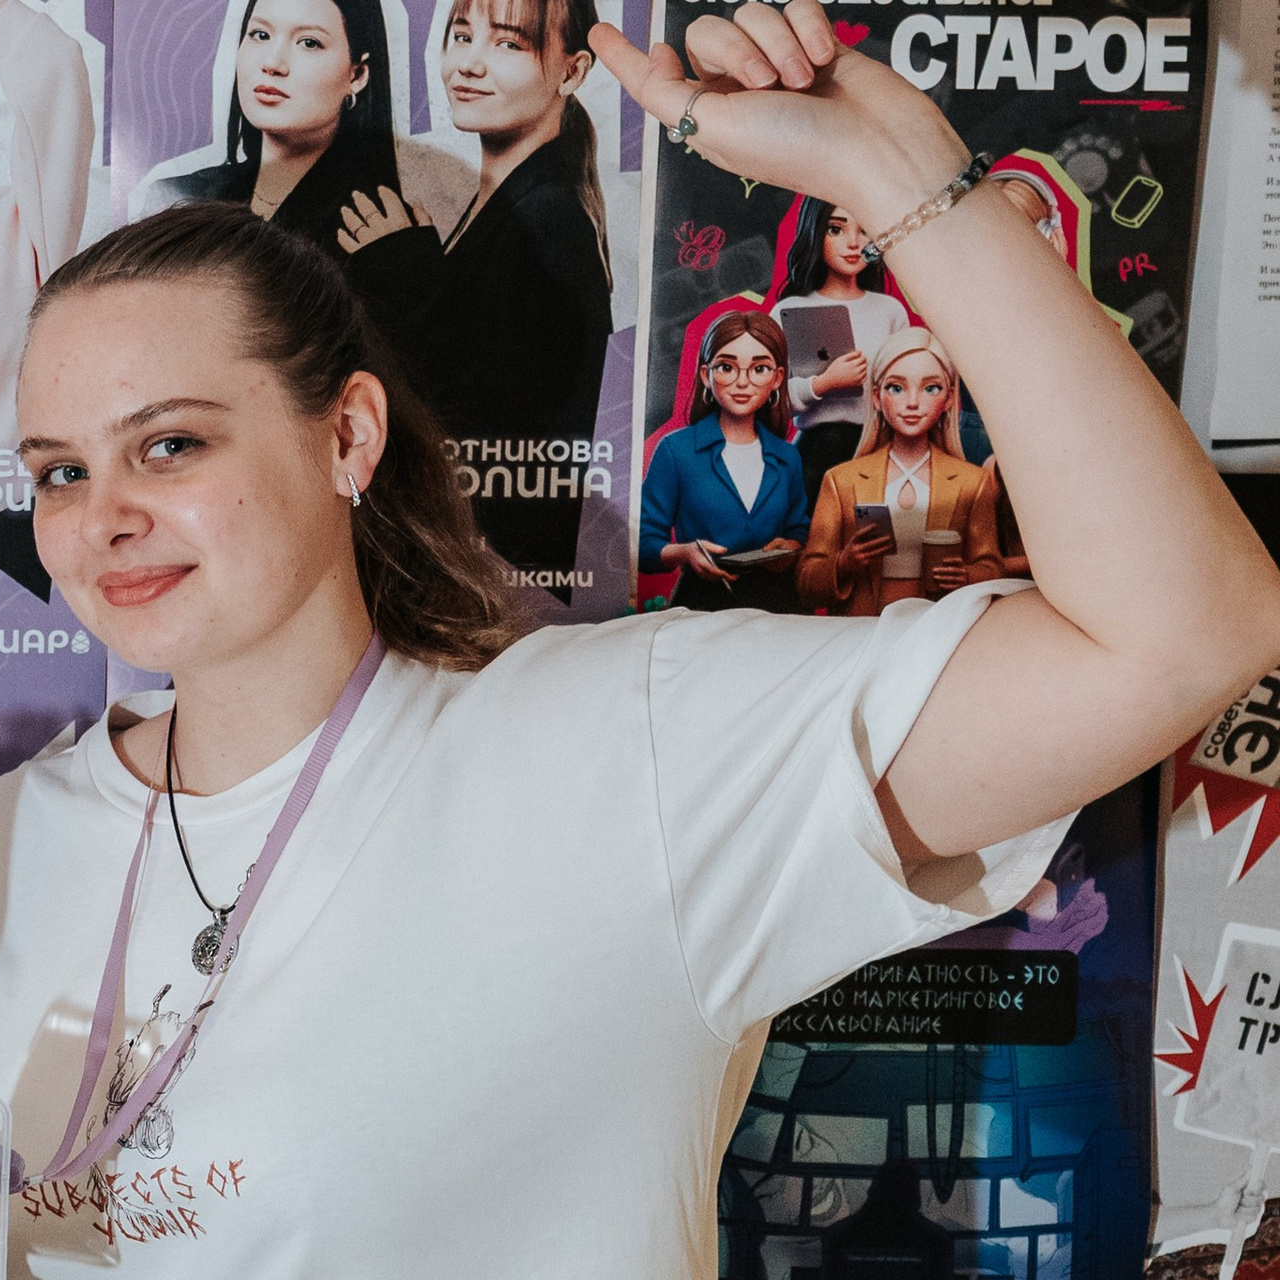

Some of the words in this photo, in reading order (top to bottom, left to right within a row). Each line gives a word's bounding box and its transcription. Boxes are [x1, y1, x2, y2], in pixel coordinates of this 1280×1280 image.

[890, 13, 1191, 93] СТАРОЕ
[1119, 252, 1158, 282] PR
[854, 964, 999, 984] ПРИВАТНОСТЬ
[1023, 965, 1060, 985] ЭТО
[854, 990, 1024, 1011] МАРКЕТИНГОВОЕ
[775, 1014, 942, 1035] ИССЛЕДОВАНИЕ
[22, 1165, 196, 1221] SUBJECTS
[207, 1158, 246, 1200] OF
